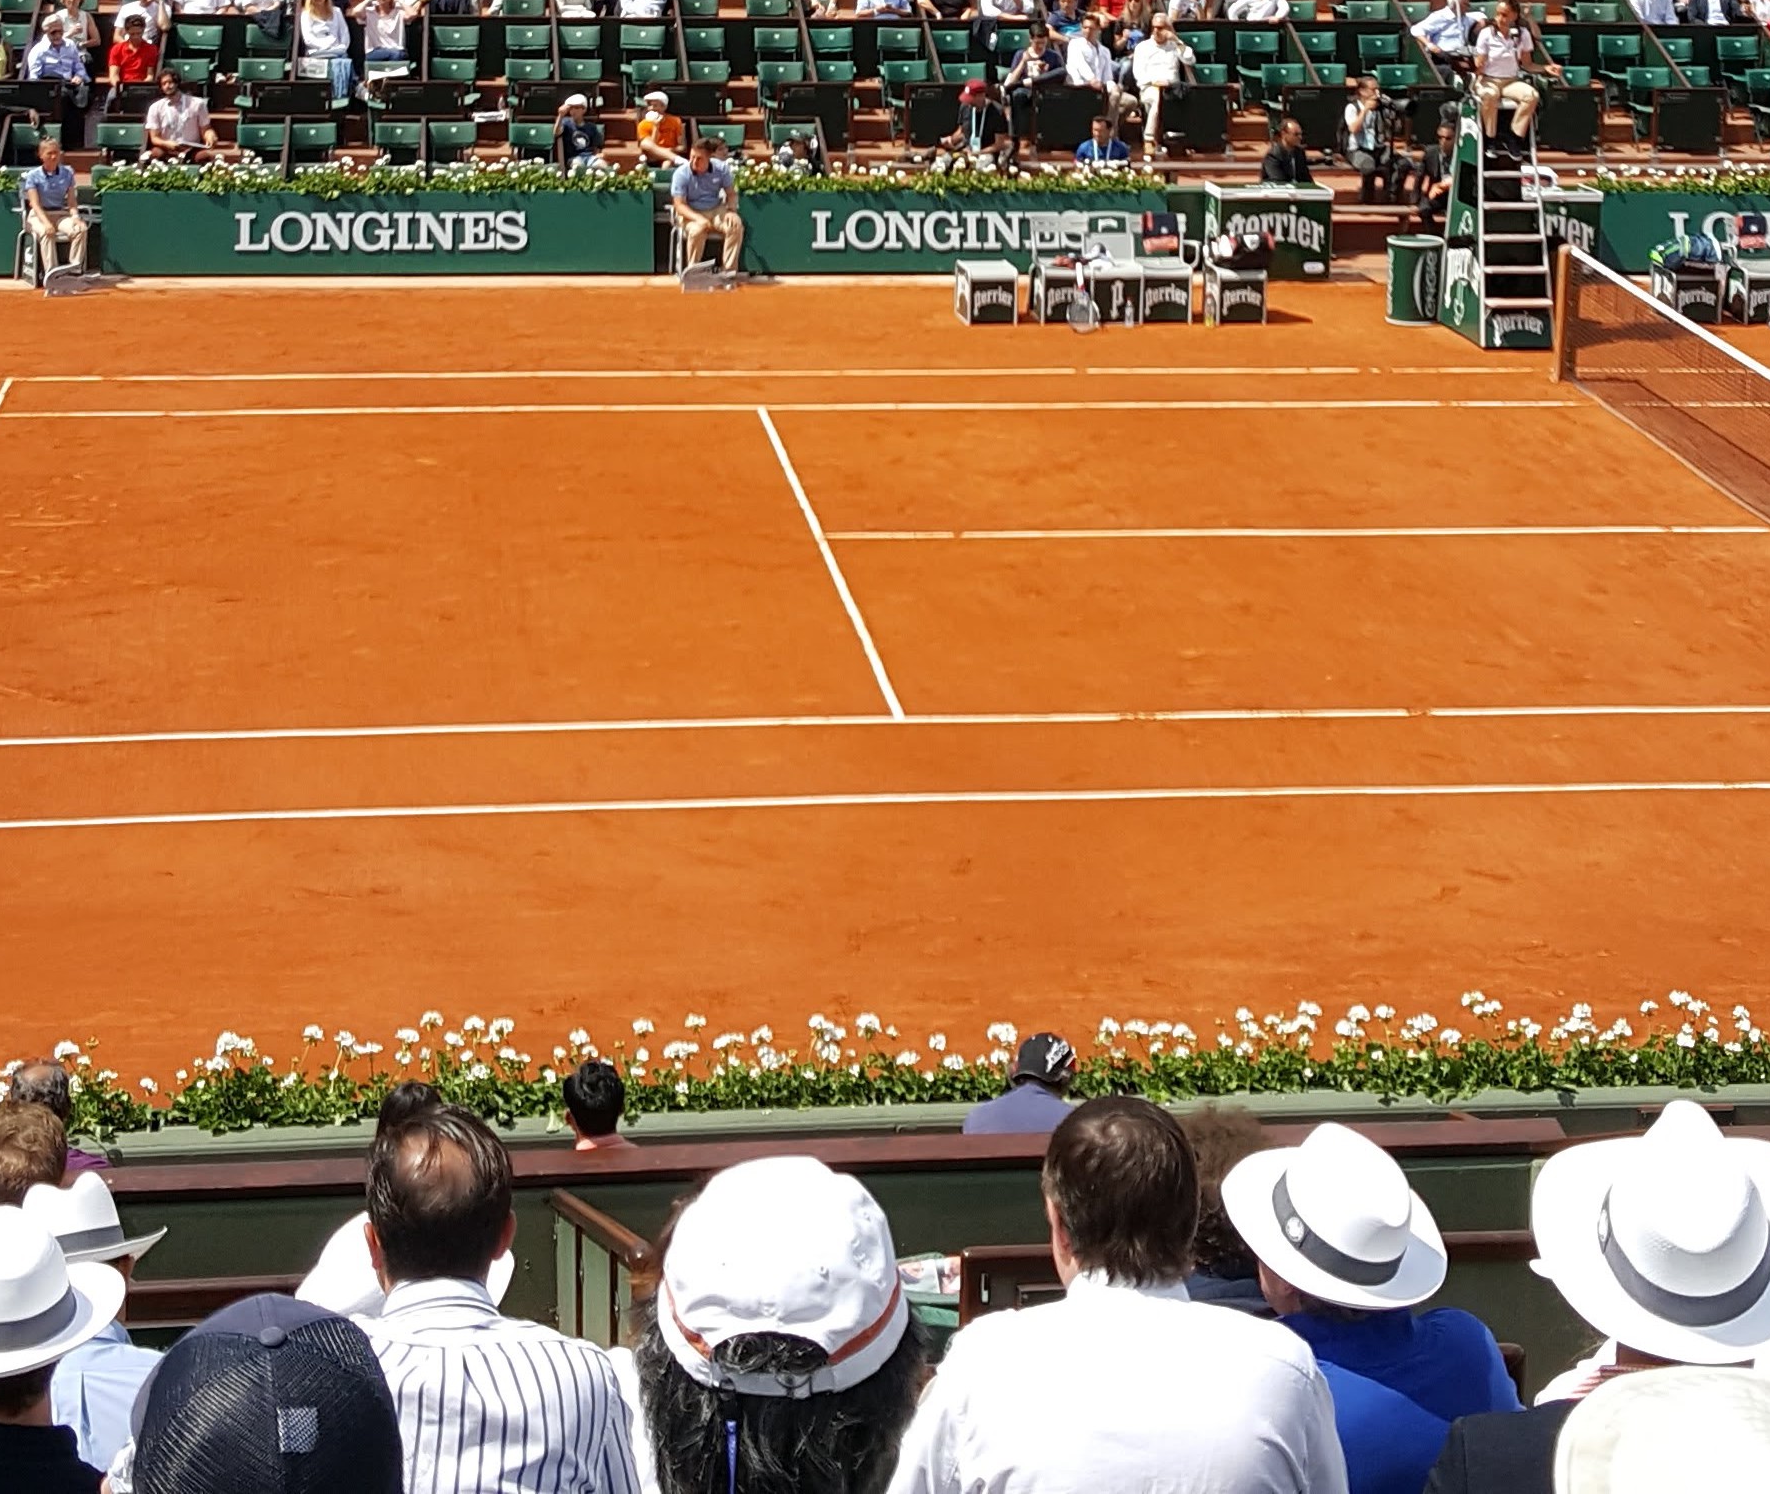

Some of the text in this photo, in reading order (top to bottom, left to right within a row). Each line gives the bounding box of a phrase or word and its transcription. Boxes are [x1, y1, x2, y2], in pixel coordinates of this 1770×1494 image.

[233, 209, 529, 252] LONGINES
[973, 285, 1014, 317] perrier
[1145, 283, 1188, 317] perrier
[1222, 286, 1262, 317] perrier
[1492, 310, 1545, 348] perrier
